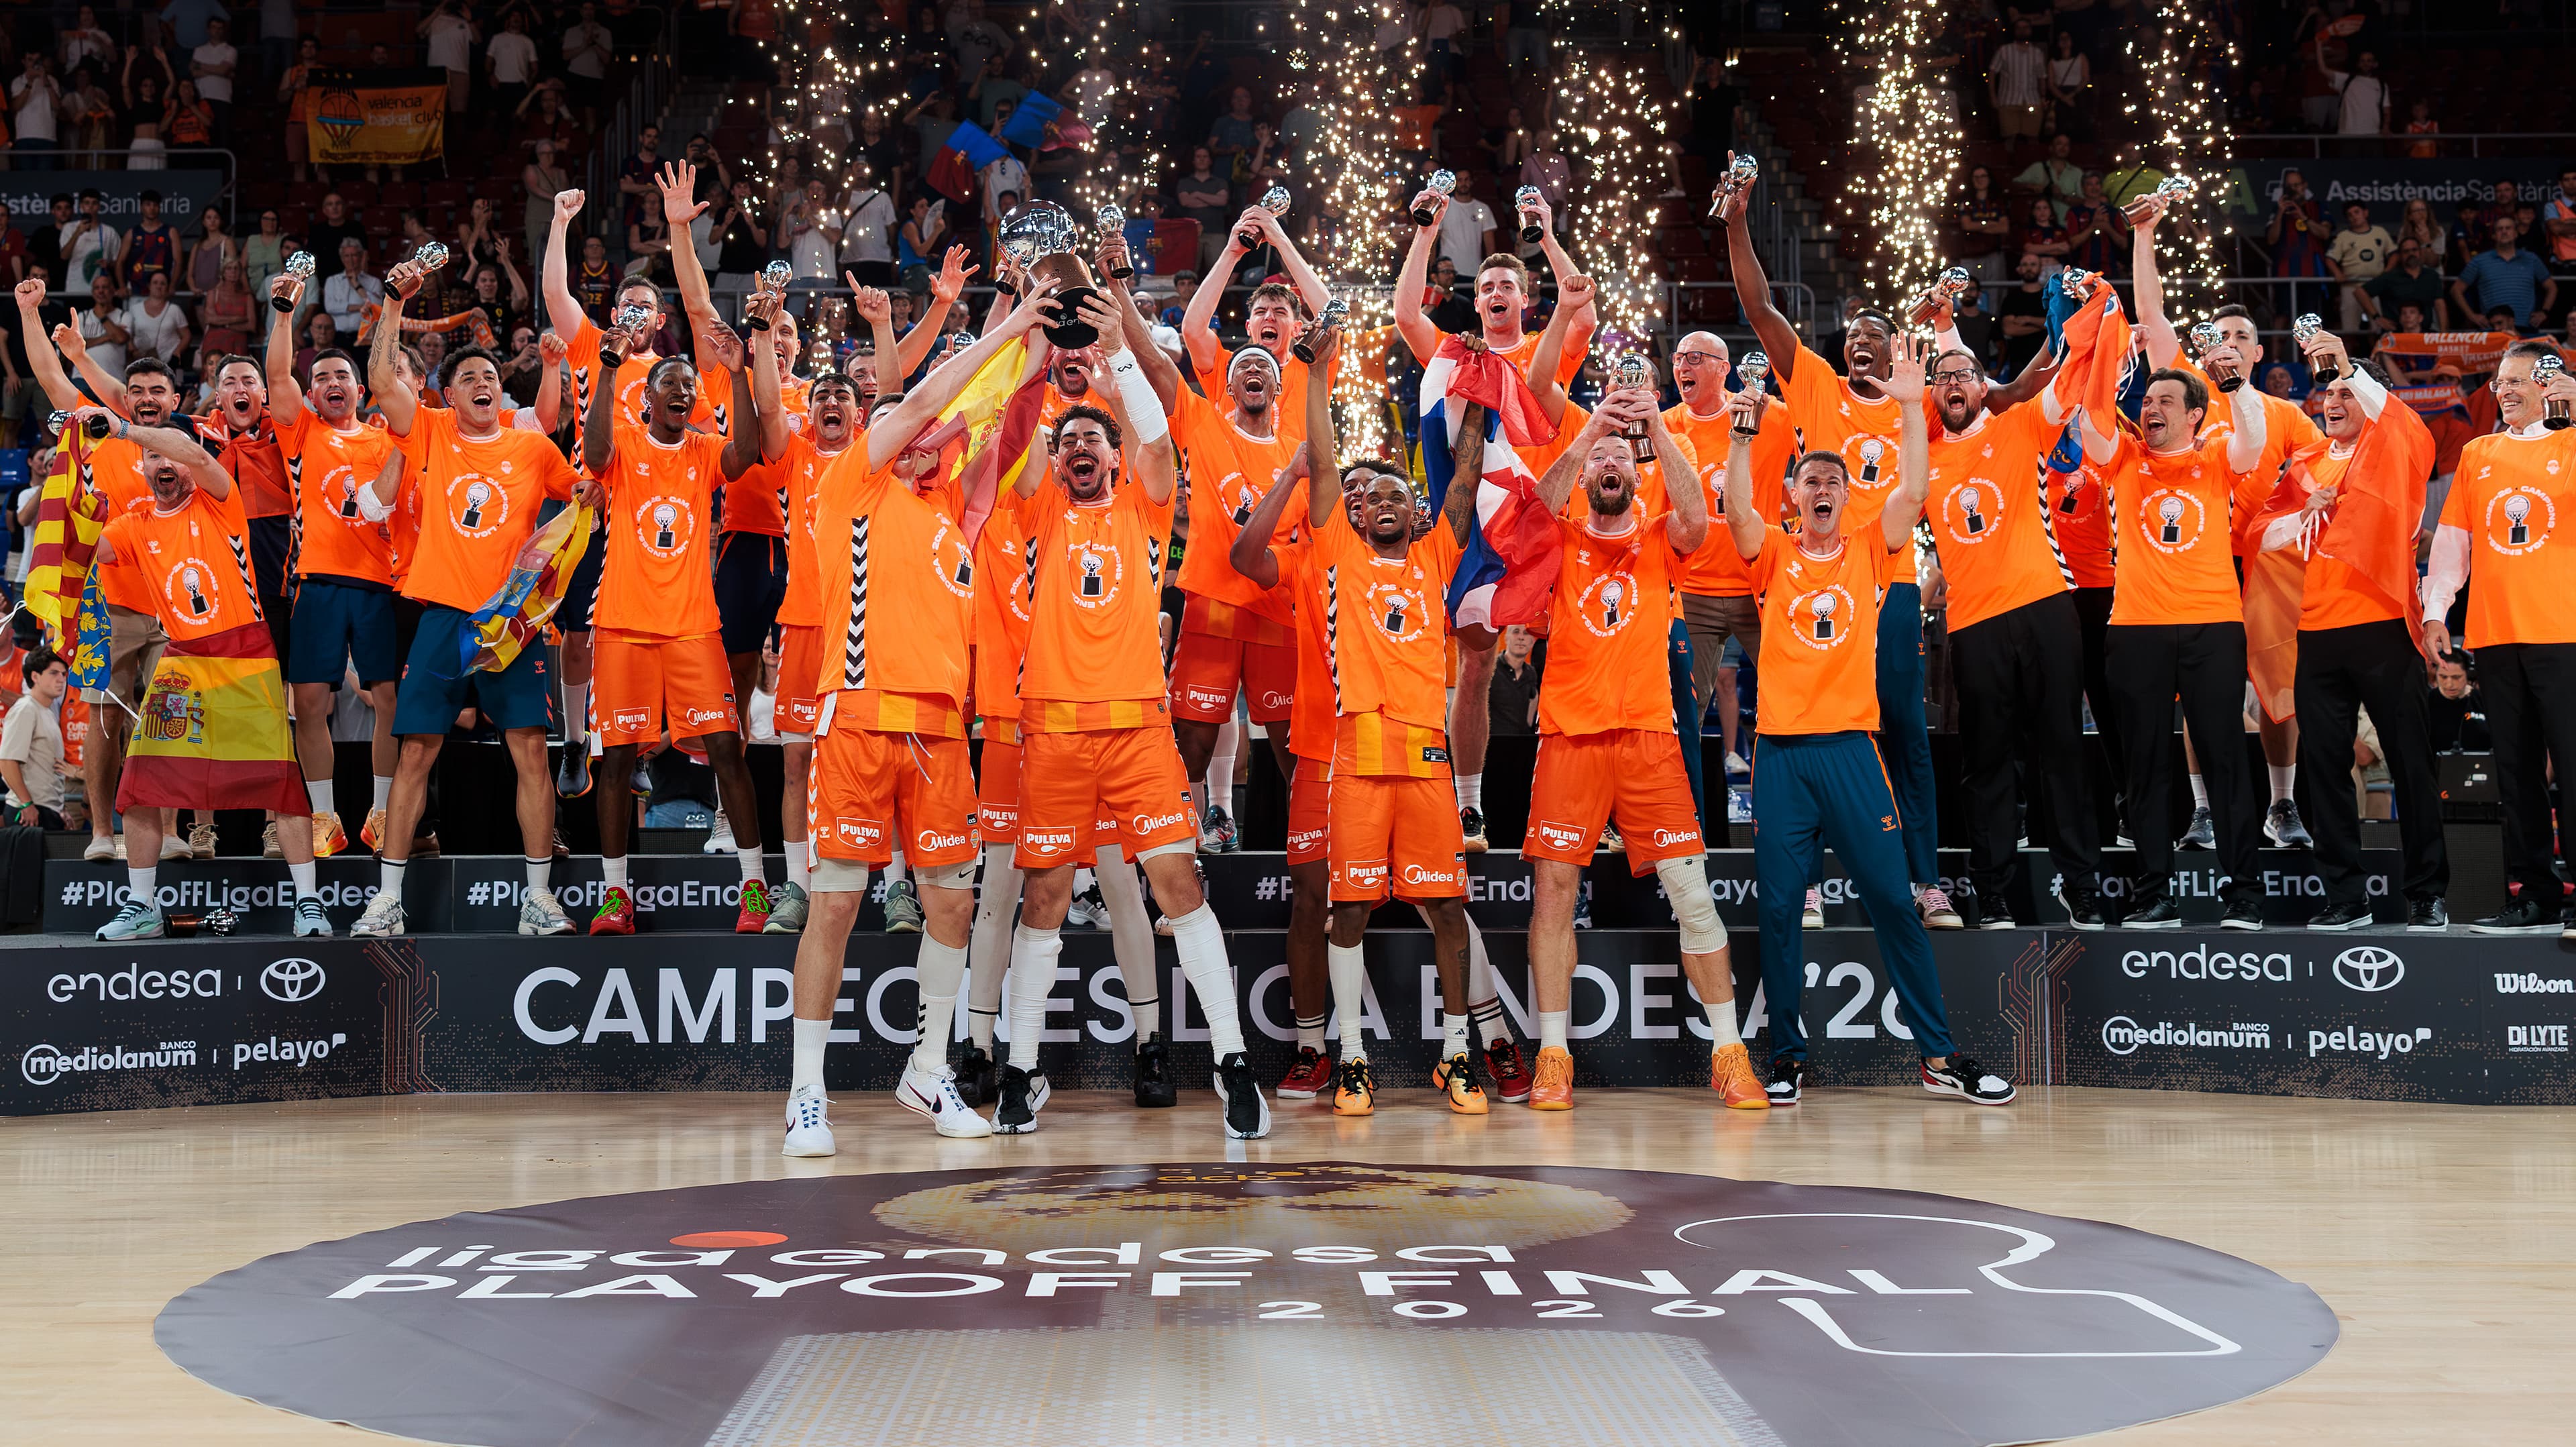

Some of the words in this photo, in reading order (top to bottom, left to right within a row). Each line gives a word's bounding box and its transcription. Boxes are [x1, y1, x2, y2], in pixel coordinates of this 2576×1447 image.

[367, 95, 422, 109] valencia
[368, 111, 411, 126] basket
[2424, 333, 2488, 345] VALENCIA
[486, 477, 508, 525] CAMPIONS
[1969, 477, 2004, 510] CAMPIONS
[2176, 489, 2204, 533] CAMPIONS
[2520, 486, 2555, 529] CAMPIONS
[474, 525, 496, 539] LIGA
[2141, 523, 2174, 554] ENDESA
[670, 540, 688, 557] LIGA
[2176, 537, 2199, 553] LIGA
[2487, 533, 2522, 555] ENDESA
[2525, 533, 2549, 553] LIGA
[932, 558, 965, 598] ENDESA
[1578, 574, 1609, 608] 2025-26
[1615, 571, 1638, 605] CAPIONS
[172, 605, 209, 625] ENDESA
[1010, 600, 1030, 621] DESA
[1189, 690, 1226, 703] PULEVA
[1271, 695, 1293, 706] Mid
[694, 710, 724, 722] Midea
[1095, 820, 1117, 830] dea
[1142, 813, 1183, 832] Midea
[930, 835, 965, 849] Midea
[1026, 833, 1071, 844] PULEVA
[1542, 826, 1579, 842] PULEVA
[1661, 830, 1698, 845] Midea
[1350, 865, 1387, 878] PULEVA
[1412, 871, 1453, 883] Midea
[2122, 943, 2292, 981] endesa
[48, 963, 221, 1002] endesa
[2494, 973, 2576, 993] Wilson
[1172, 963, 1391, 1042] LGA
[2109, 1021, 2270, 1049] mediolanum
[2233, 1023, 2269, 1032] BANCO
[2530, 1025, 2569, 1046] LYTE
[160, 1040, 196, 1050] BANCO
[2310, 1025, 2413, 1059] pelayo
[30, 1047, 196, 1075] mediolanum
[234, 1036, 329, 1070] pelayo
[325, 1271, 1253, 1299] PLAYOFF
[1358, 1268, 1974, 1295] FINAL
